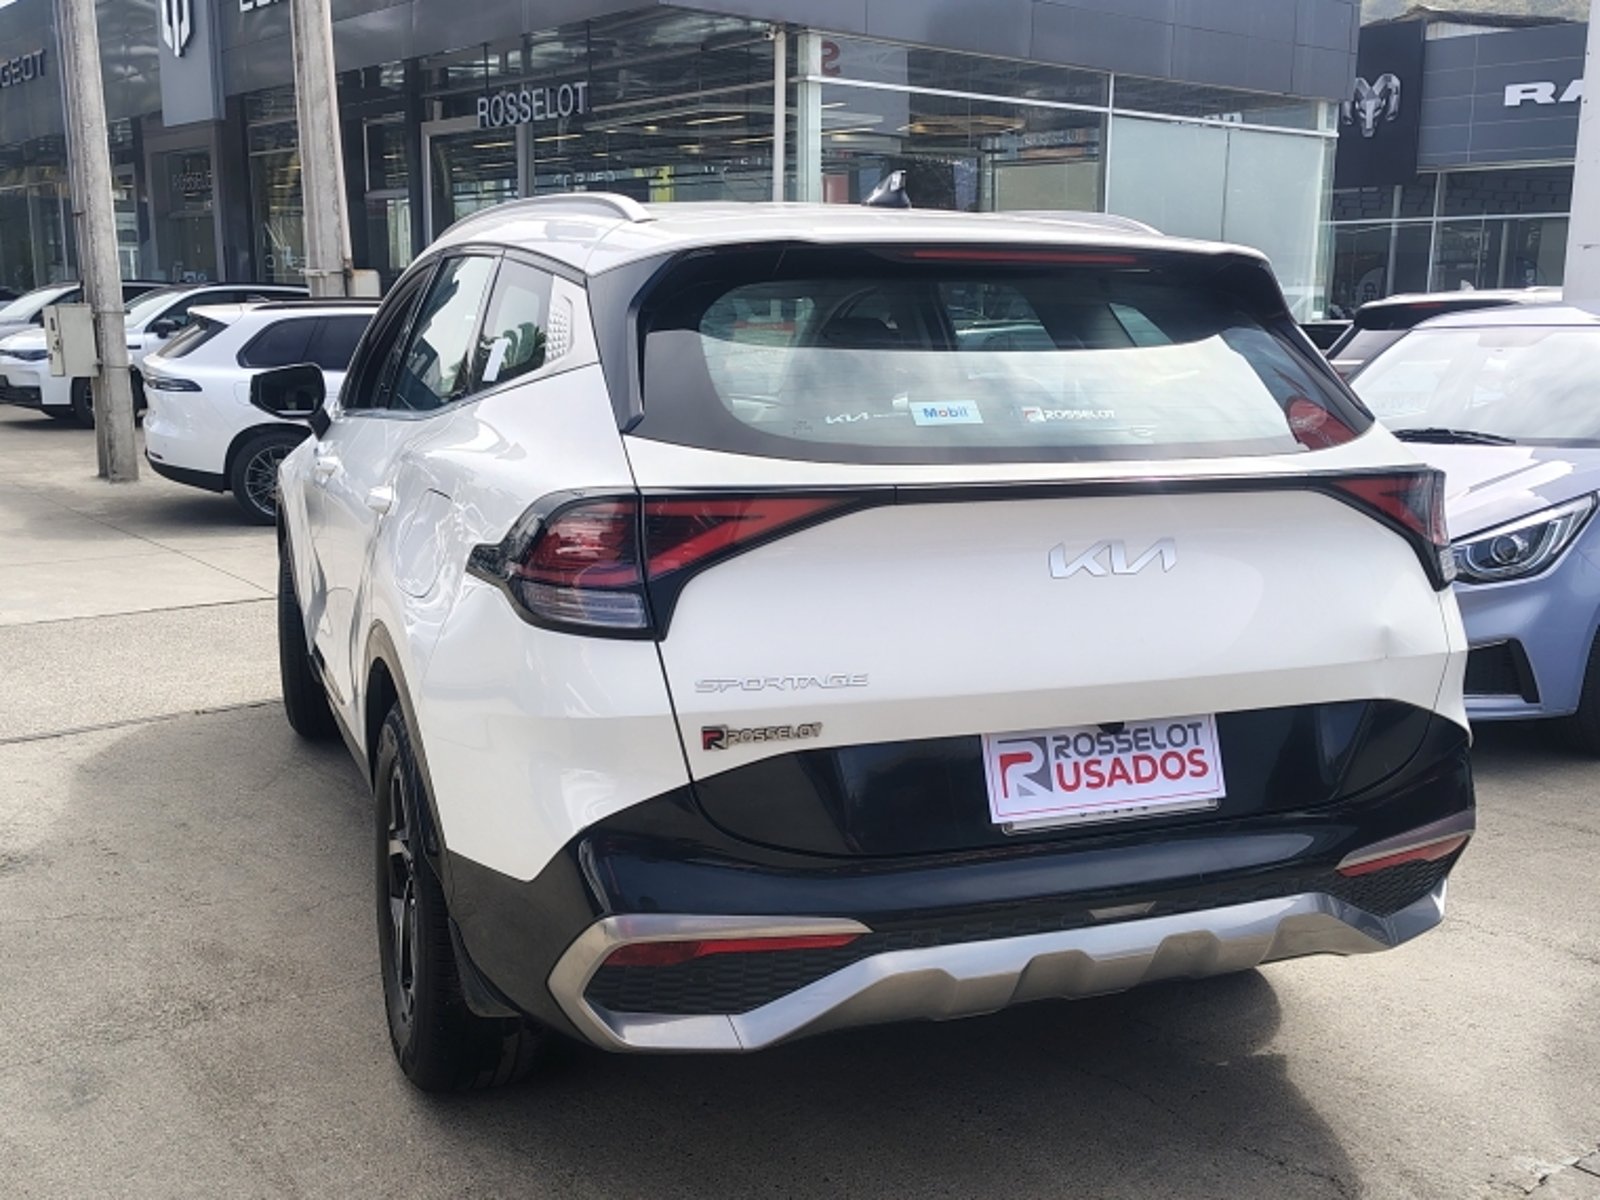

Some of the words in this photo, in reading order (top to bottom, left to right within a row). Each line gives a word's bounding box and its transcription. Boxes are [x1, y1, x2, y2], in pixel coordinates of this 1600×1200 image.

[477, 81, 588, 129] ROSSELOT
[923, 407, 969, 418] Mobil
[1048, 537, 1178, 580] KIA
[694, 672, 869, 694] SPORTAGE
[726, 721, 823, 747] ROSSELOT
[1052, 723, 1203, 760] ROSSELOT
[1056, 748, 1209, 793] USADOS
